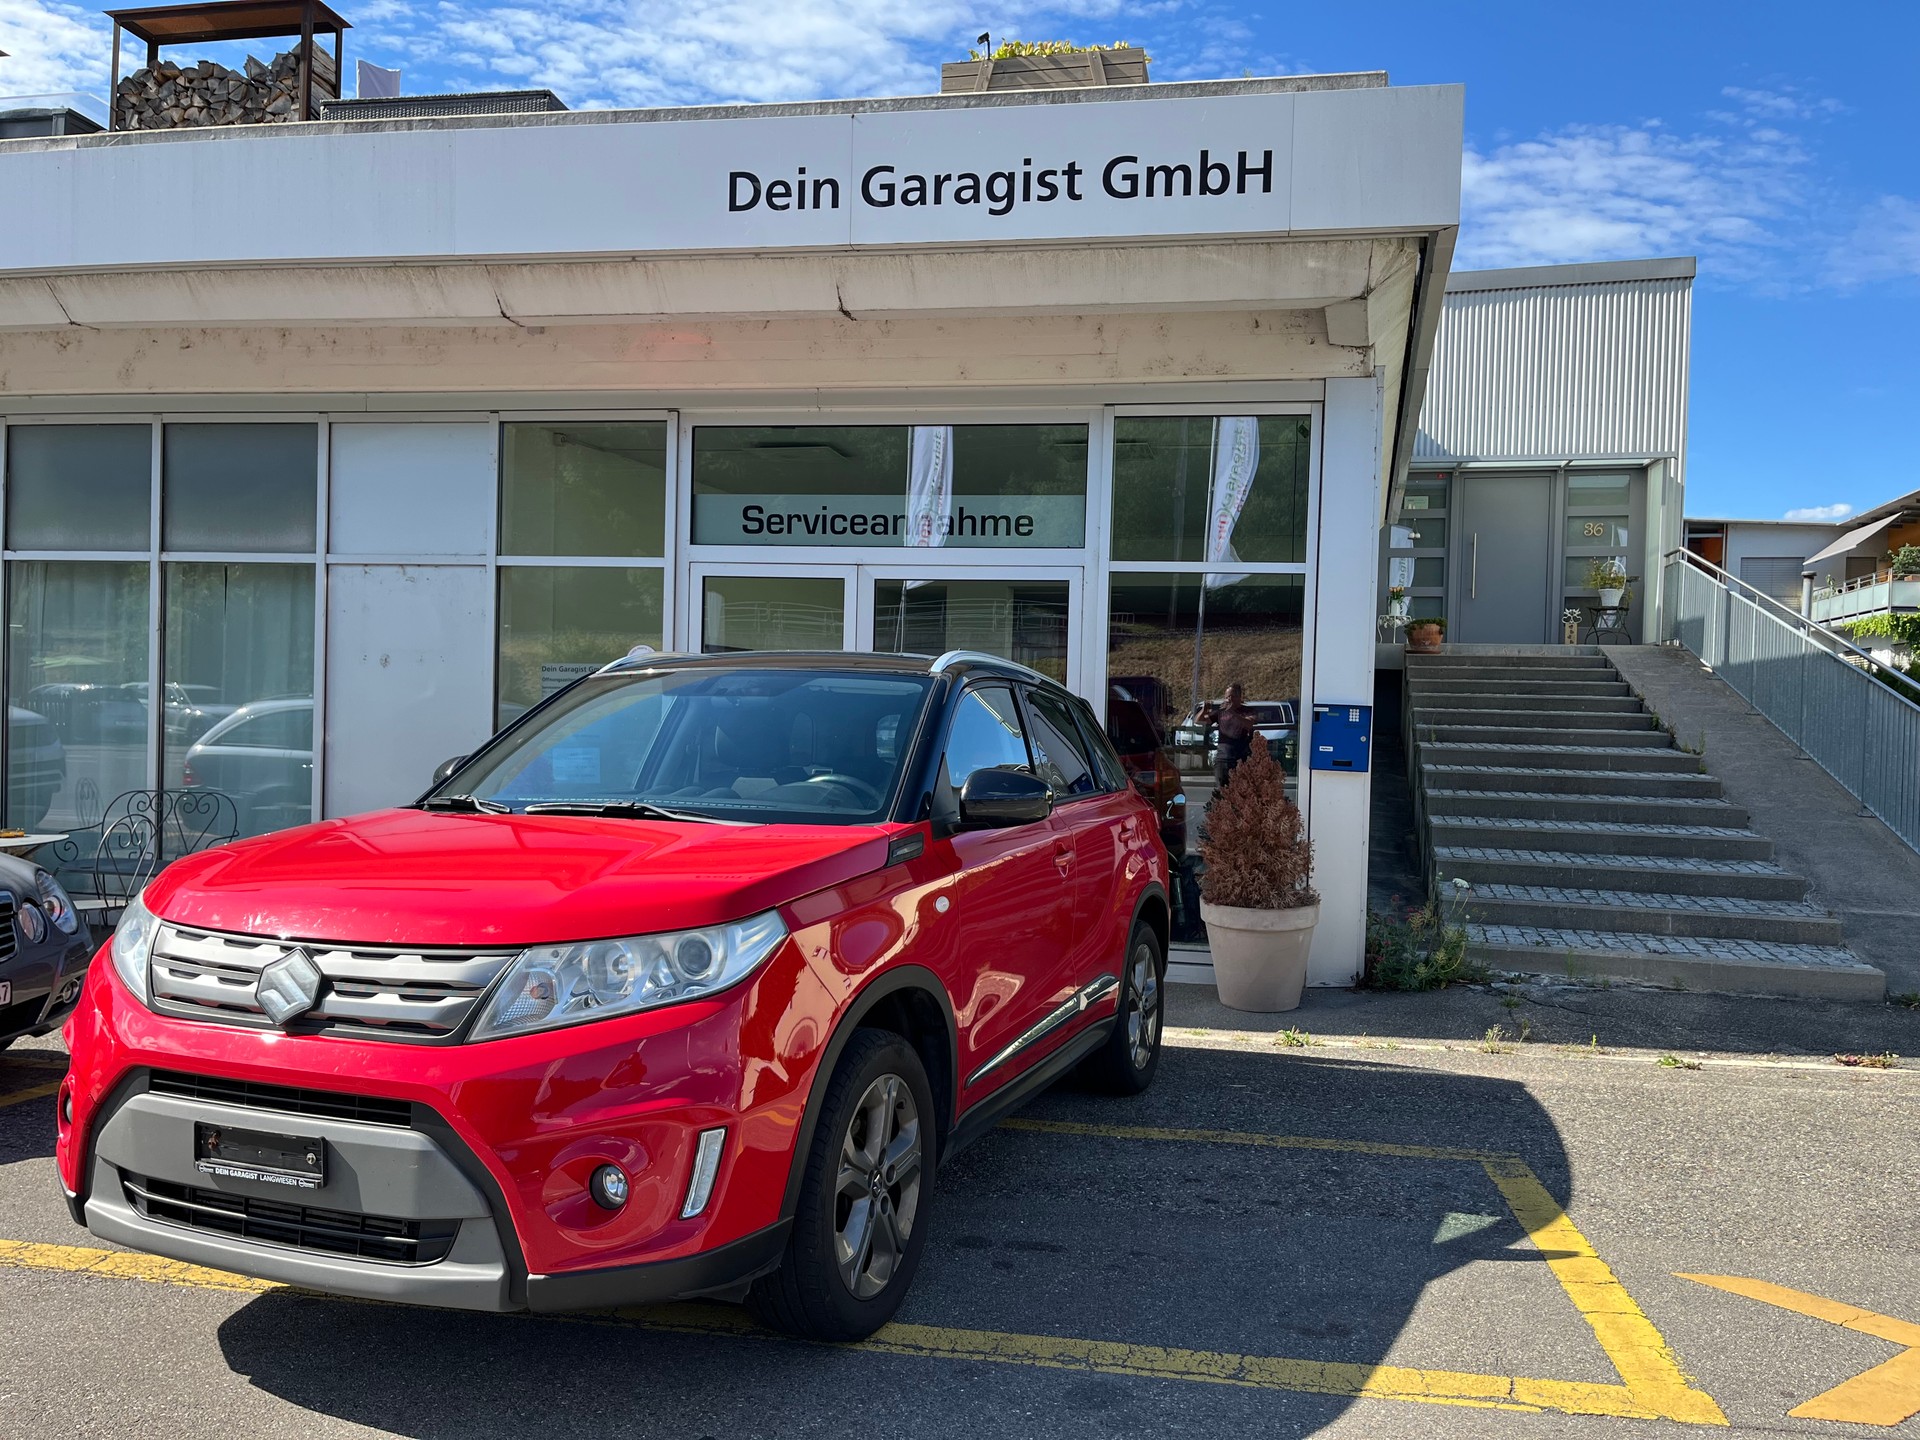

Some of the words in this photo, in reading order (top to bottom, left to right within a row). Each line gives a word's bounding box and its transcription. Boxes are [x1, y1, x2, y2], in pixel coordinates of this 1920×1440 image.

[728, 166, 840, 213] Dein
[860, 158, 1083, 216] Garagist
[1102, 149, 1274, 200] GmbH
[1583, 522, 1604, 537] 36
[541, 665, 557, 673] Dein
[558, 665, 587, 674] Garagist
[215, 1167, 229, 1176] DEIN
[229, 1170, 258, 1180] GARAGIST
[259, 1174, 297, 1186] LANGWIESEN
